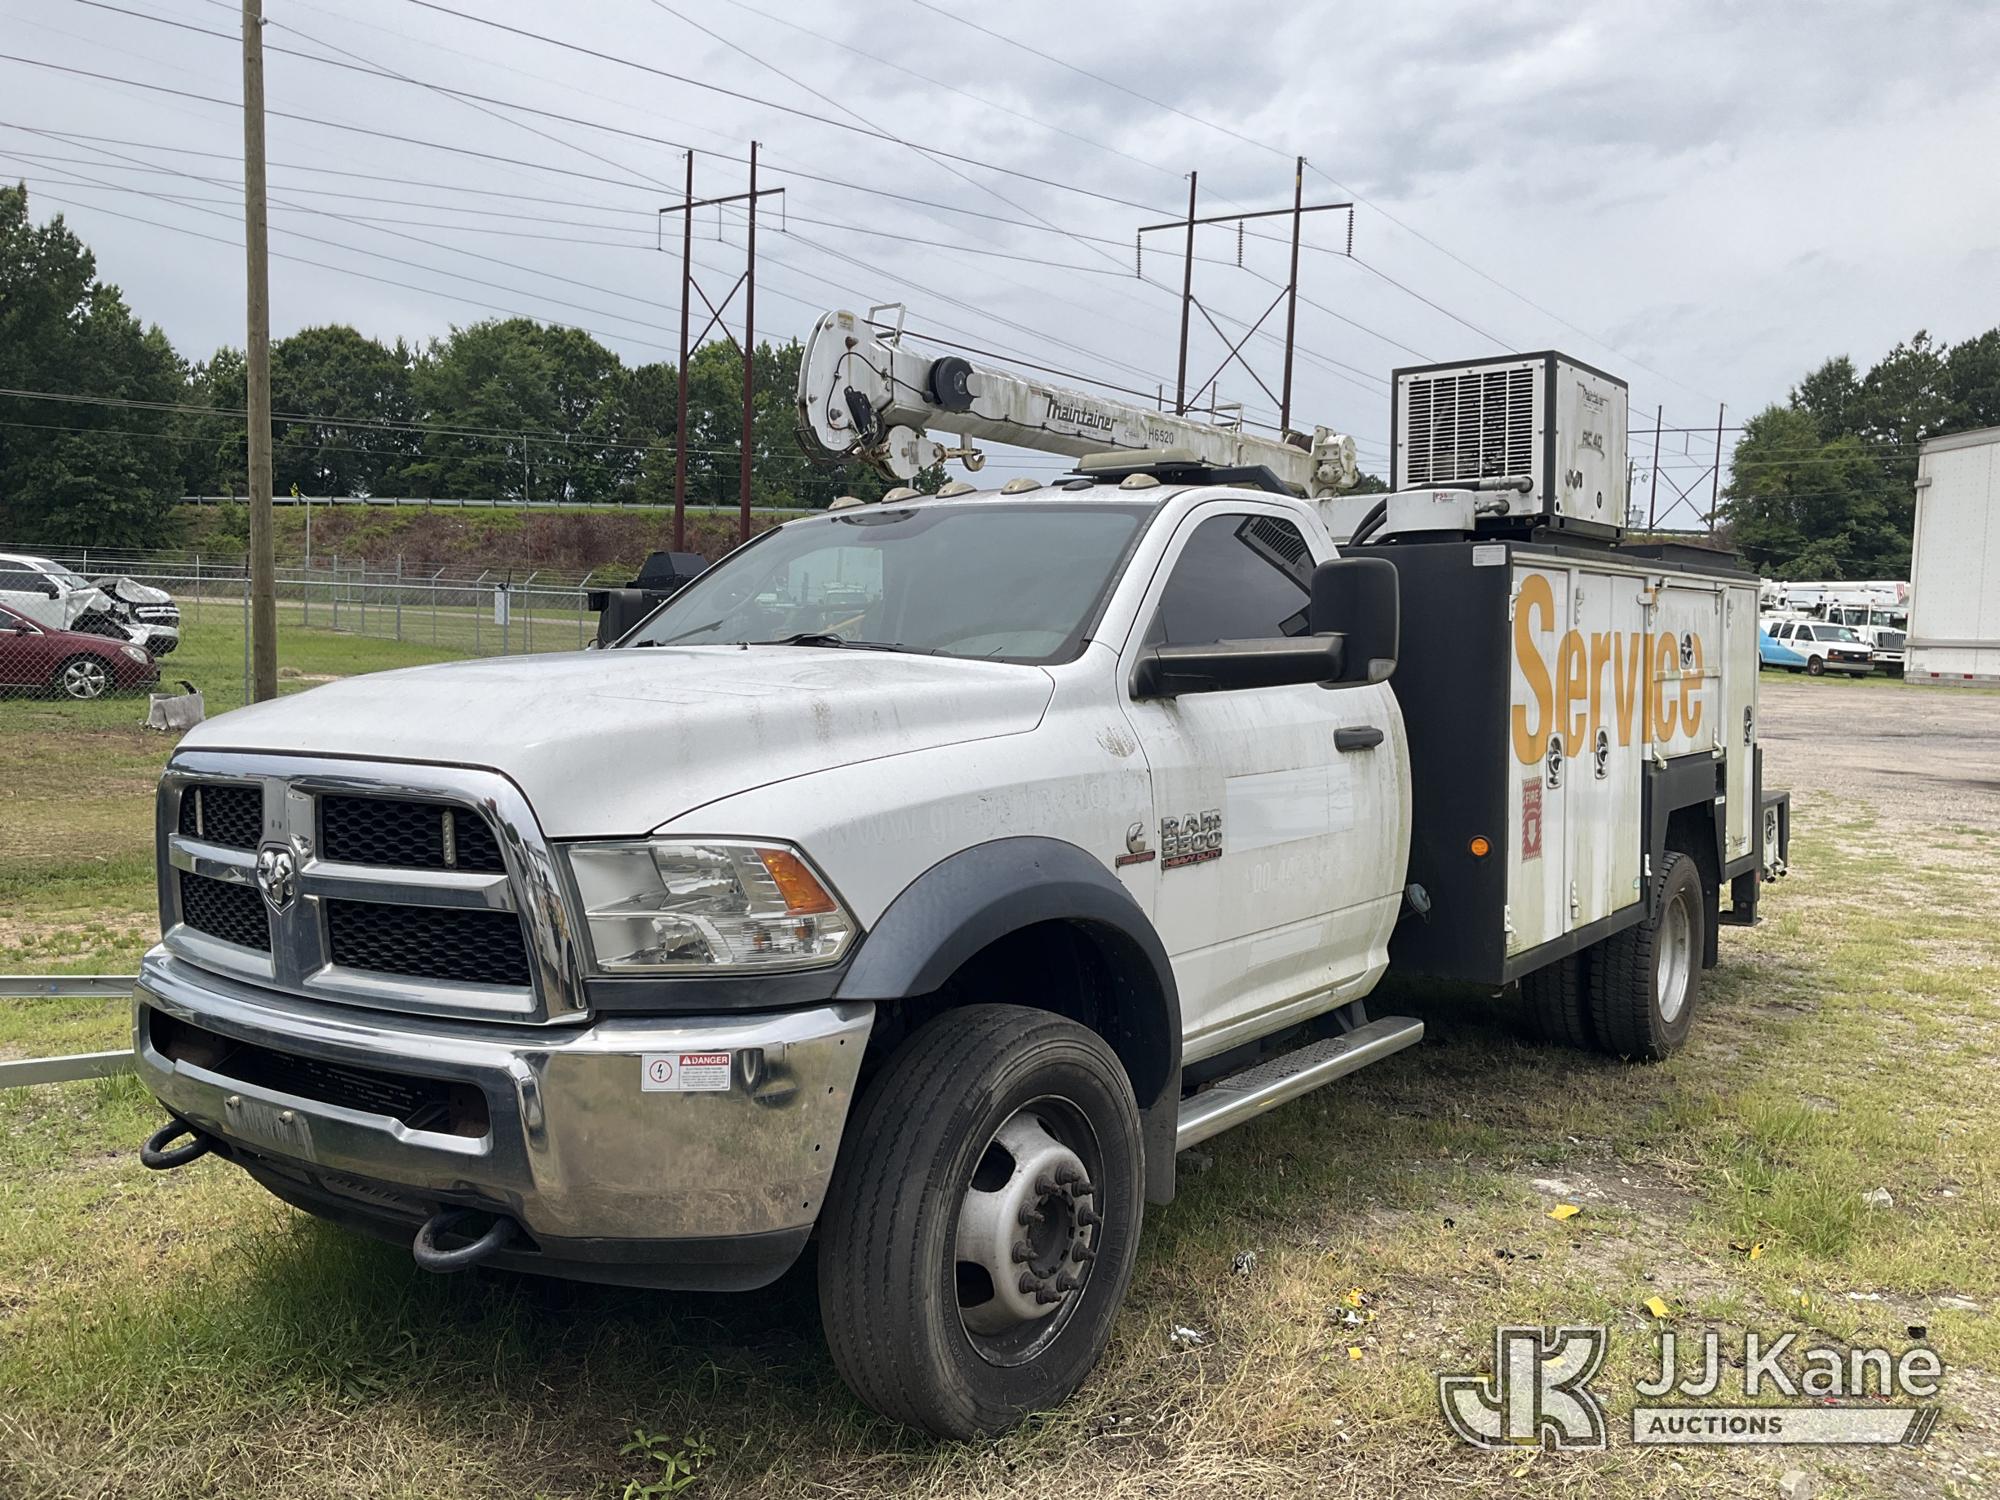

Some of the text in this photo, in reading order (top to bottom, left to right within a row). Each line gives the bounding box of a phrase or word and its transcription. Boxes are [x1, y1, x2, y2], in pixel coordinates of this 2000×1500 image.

[1149, 427, 1174, 445] H6520
[1511, 574, 1704, 765] Service
[1525, 789, 1540, 804] FIRE
[1161, 808, 1222, 838] RAM
[1197, 850, 1219, 861] DUTY
[691, 1056, 728, 1065] DANGER
